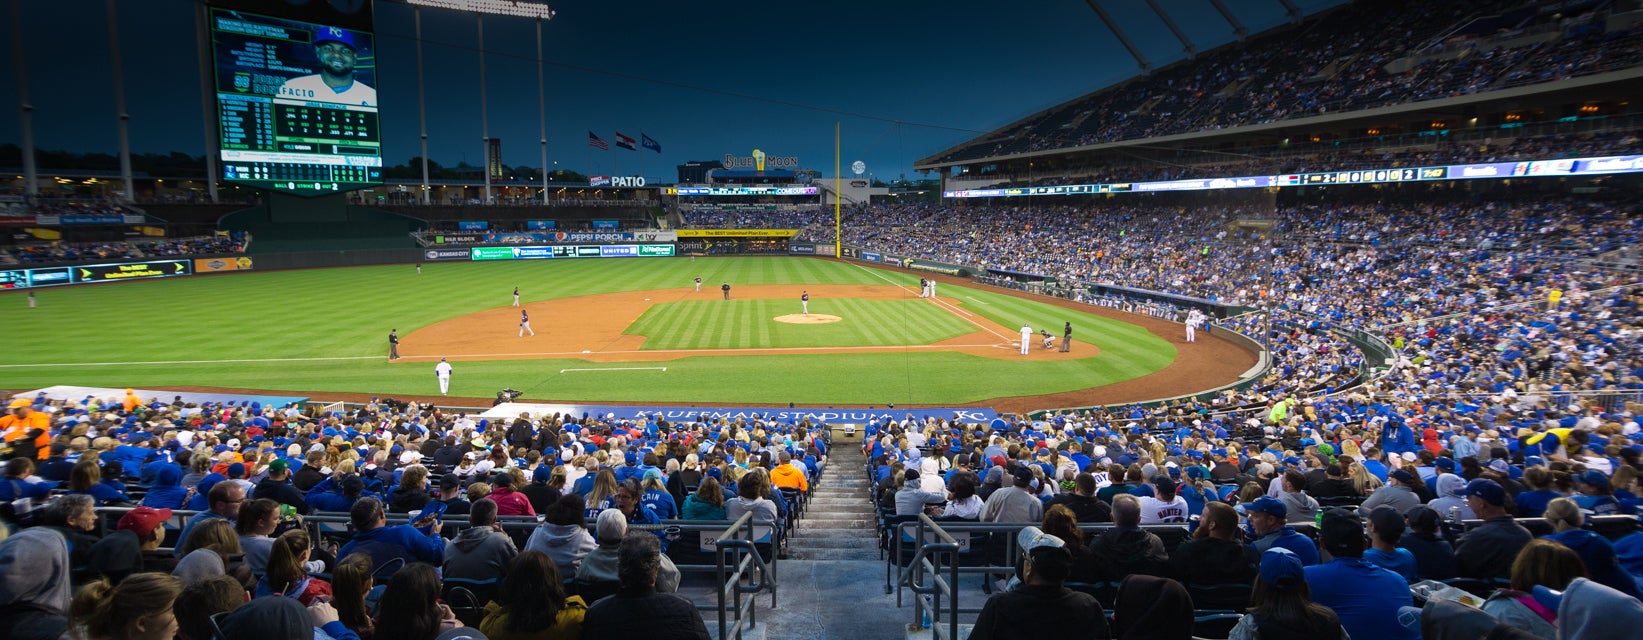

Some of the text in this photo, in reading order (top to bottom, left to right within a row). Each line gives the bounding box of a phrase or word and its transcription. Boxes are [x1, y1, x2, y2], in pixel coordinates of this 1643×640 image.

[252, 74, 286, 84] JORGE
[723, 154, 798, 169] BLUE MOON
[1352, 173, 1360, 181] 0
[1378, 172, 1386, 180] 0
[1404, 170, 1413, 179] 2
[612, 177, 645, 187] PATIO
[680, 241, 703, 251] Sprint
[634, 410, 768, 419] KAUFFMAN
[953, 410, 988, 421] KC
[641, 493, 660, 502] CAIN
[1158, 508, 1182, 519] HUNTER
